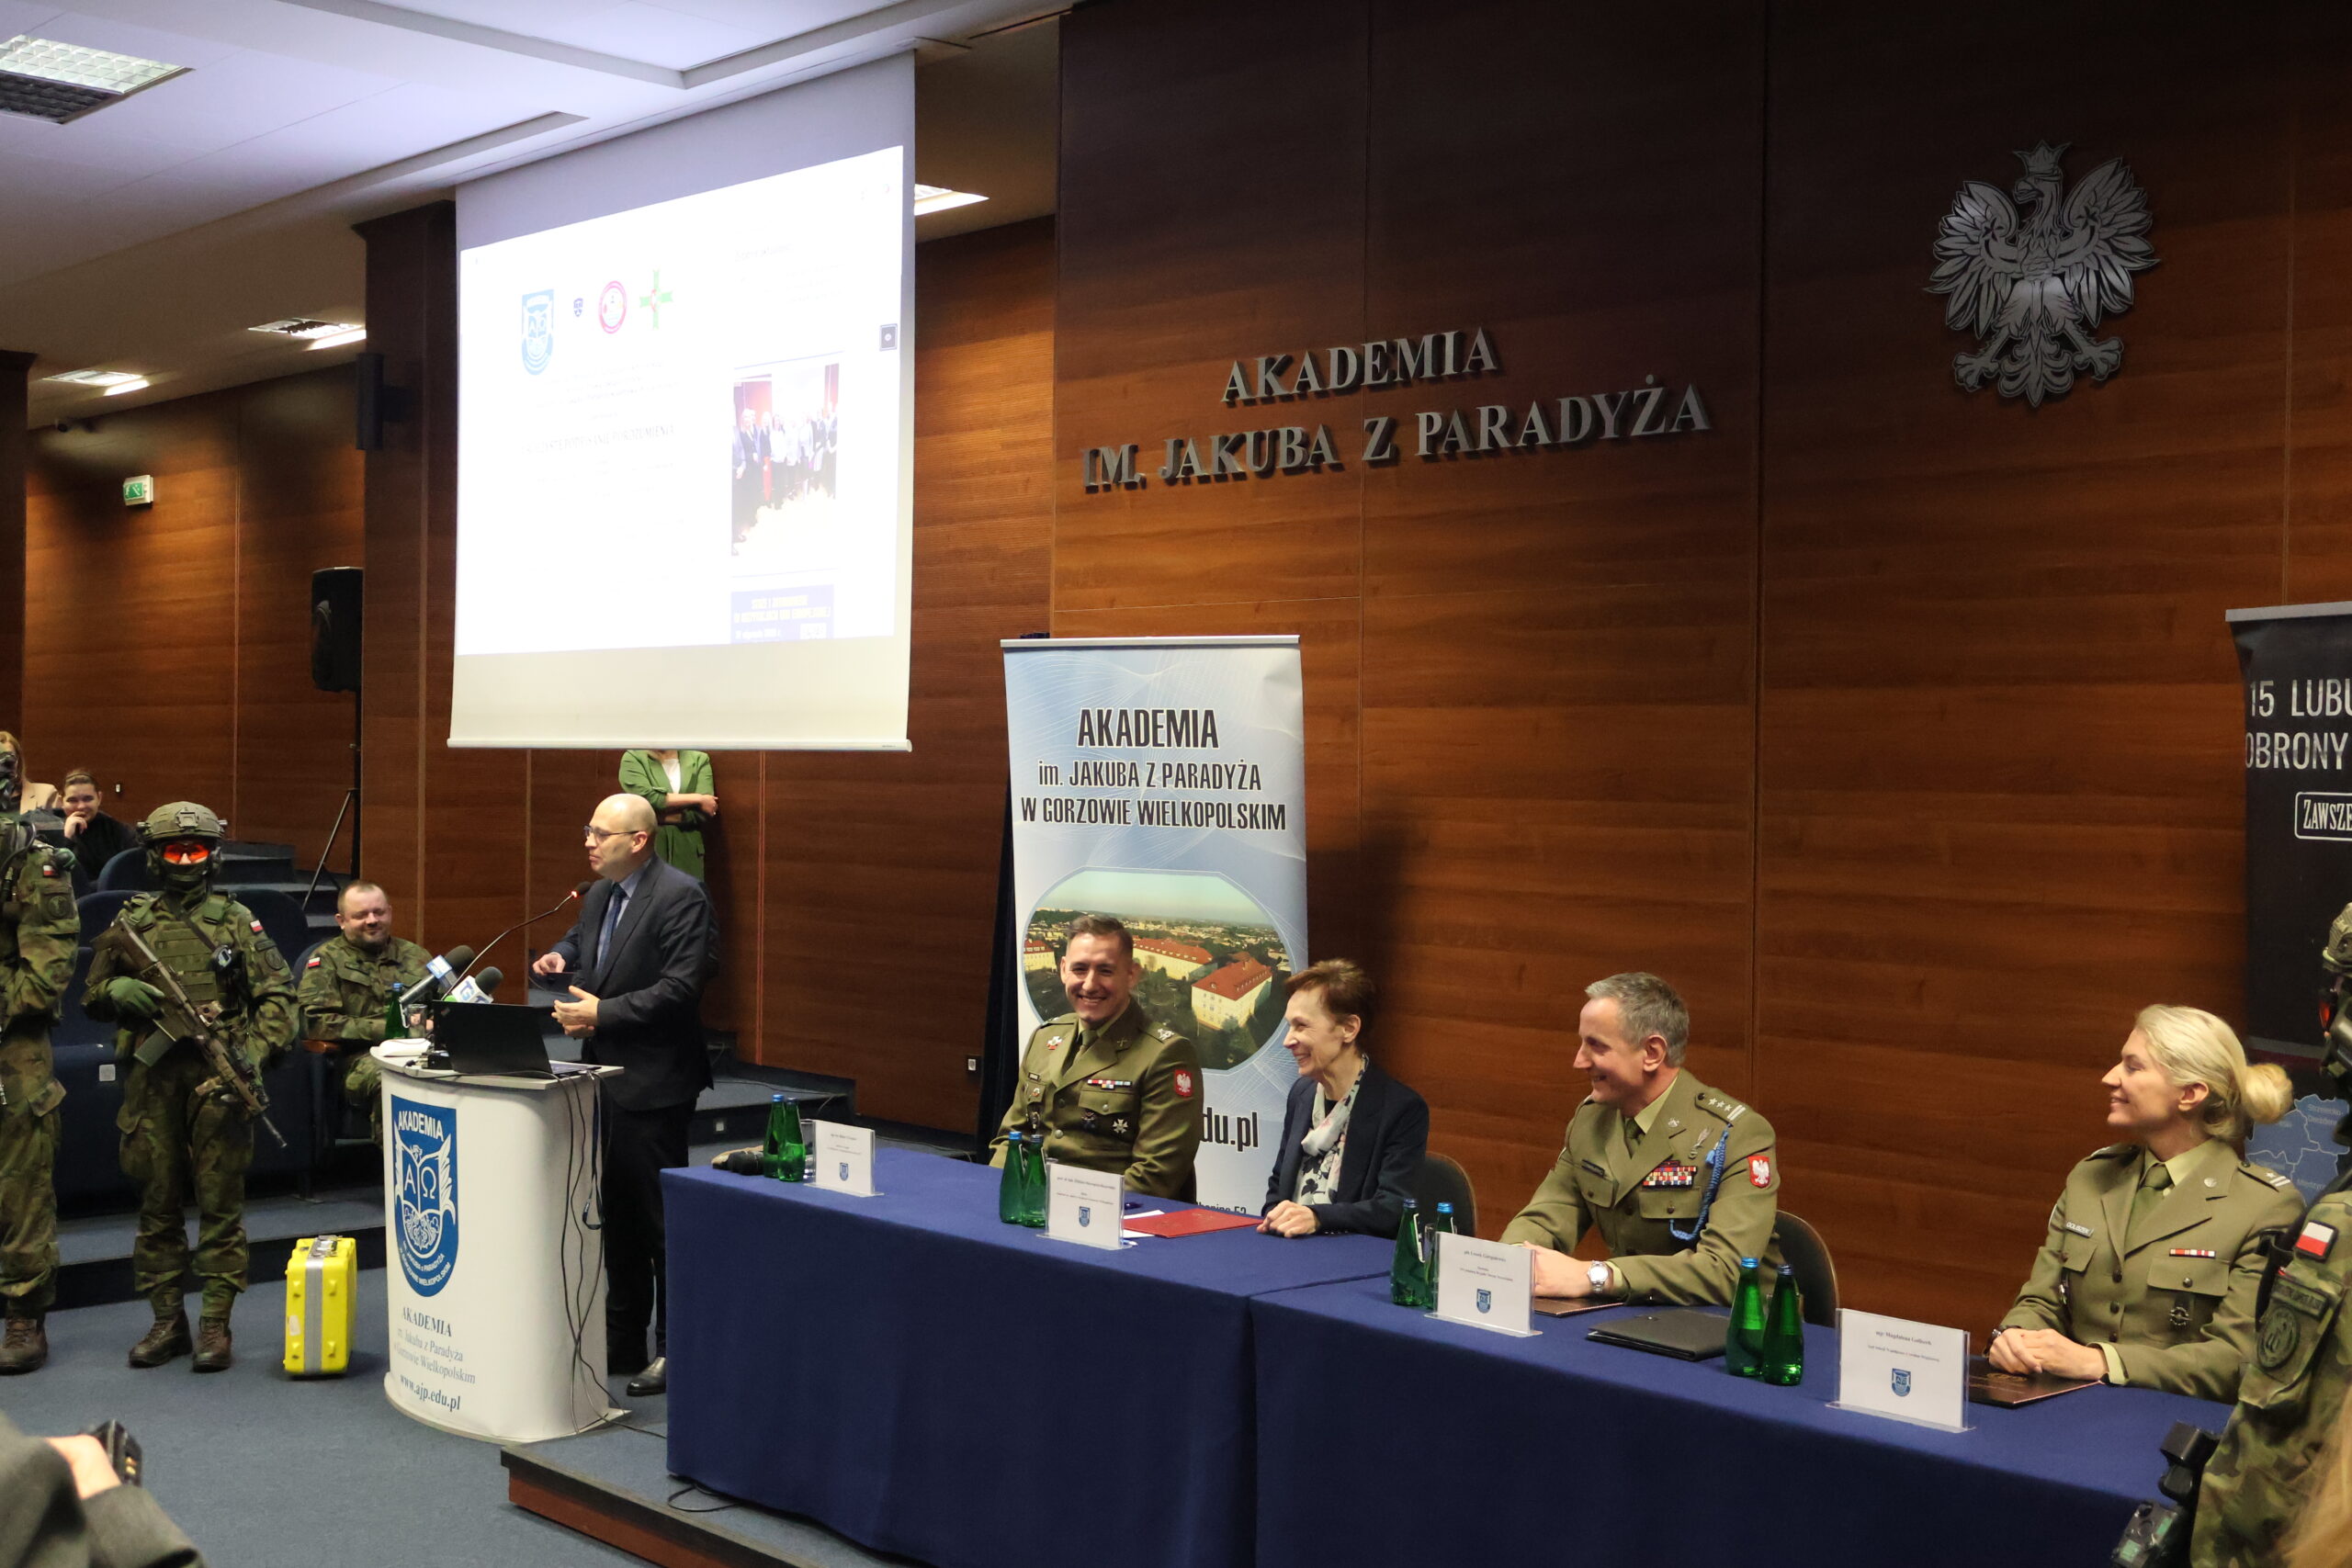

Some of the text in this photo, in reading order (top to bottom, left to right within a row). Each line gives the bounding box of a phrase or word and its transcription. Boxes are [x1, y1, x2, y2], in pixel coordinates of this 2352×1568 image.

[1220, 327, 1498, 403] AKADEMIA
[1081, 374, 1712, 487] IM. JAKUBA Z PARADYŻA
[2250, 680, 2275, 717] 15
[1077, 708, 1220, 749] AKADEMIA
[2245, 732, 2348, 770] OBRONY
[1037, 757, 1262, 792] im. JAKUBA Z PARADYŻA
[1021, 796, 1286, 830] W GORZOWIE WIELKOPOLSKIM
[398, 1111, 445, 1142] AKADEMIA
[402, 1307, 452, 1337] AKADEMIA
[424, 1342, 429, 1352] z
[429, 1340, 464, 1362] Paradyża
[420, 1354, 476, 1385] Wielkopolskim
[400, 1373, 461, 1413] www.ajp.edu.pl
